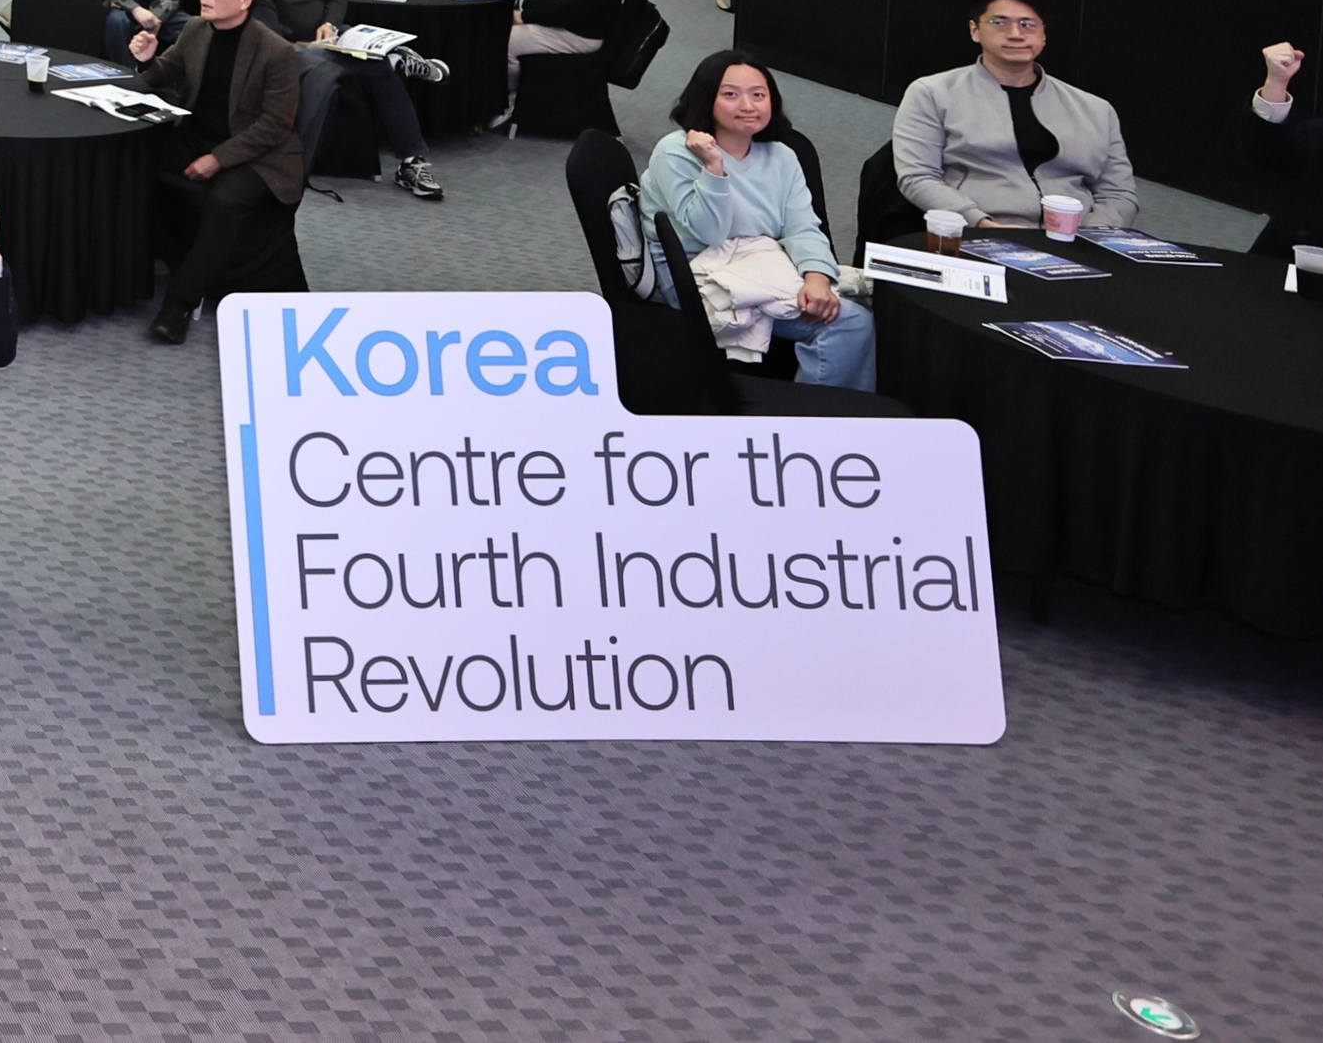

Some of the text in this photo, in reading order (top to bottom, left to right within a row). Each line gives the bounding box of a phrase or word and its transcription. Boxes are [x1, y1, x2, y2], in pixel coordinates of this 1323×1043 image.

[283, 308, 599, 397] Korea
[289, 431, 881, 509] Centre for the
[297, 531, 980, 612] Fourth Industrial
[304, 634, 735, 713] Revolution
